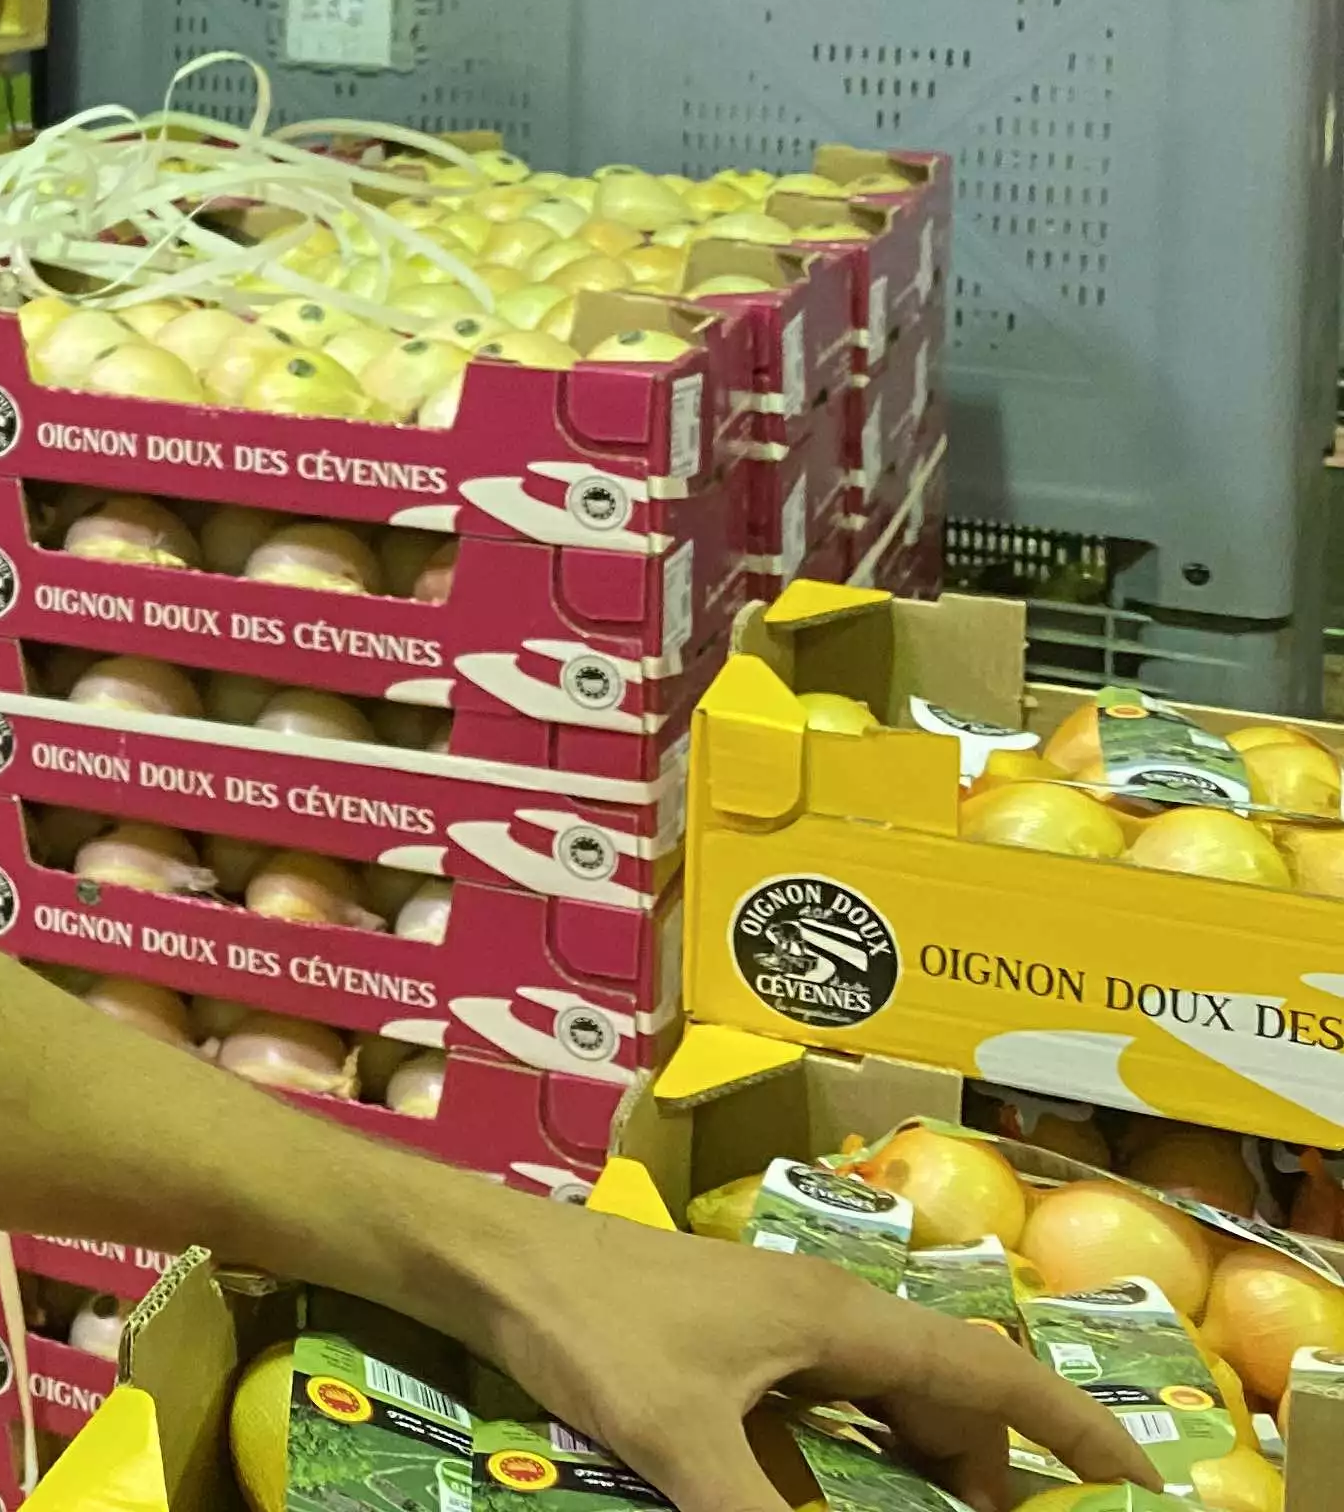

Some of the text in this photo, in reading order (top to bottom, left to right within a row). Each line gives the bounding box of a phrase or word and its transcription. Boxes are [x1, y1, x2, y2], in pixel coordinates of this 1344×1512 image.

[37, 422, 449, 495] OIGNON DOUX DES CÉVENNES
[34, 585, 443, 667] OIGNON DOUX DES CÉVENNES
[32, 742, 435, 834] OIGNON DOUX DES CÉVENNES
[33, 905, 438, 1008] OIGNON DOUX DES CÉVENNES
[740, 884, 892, 956] OIGNON DOUX
[756, 971, 872, 1014] CÉVENNES
[920, 943, 1344, 1051] OIGNON DOUX DES
